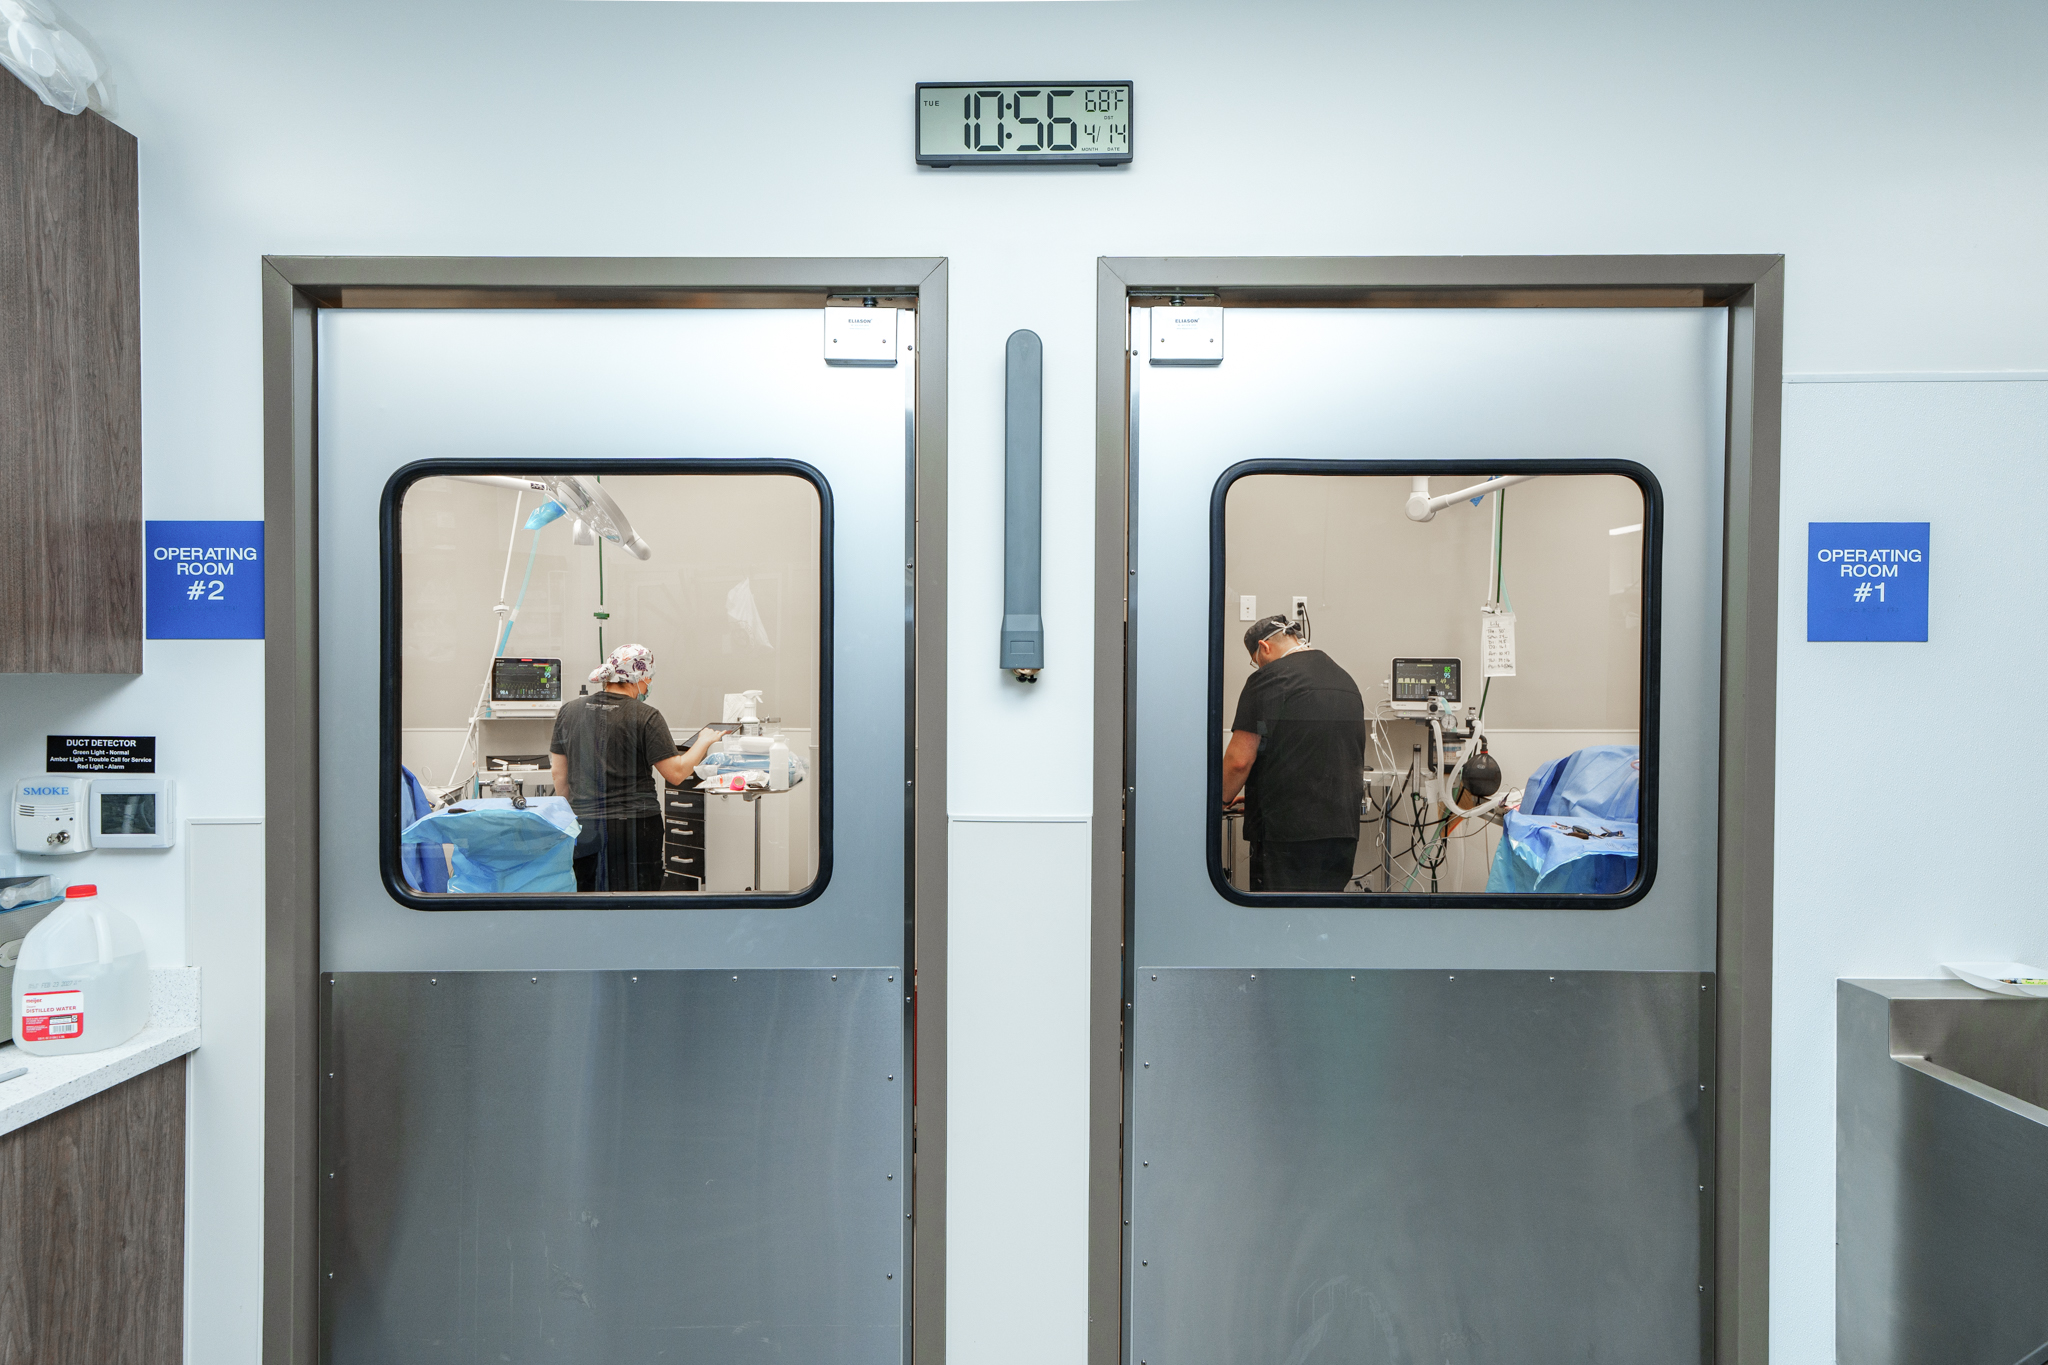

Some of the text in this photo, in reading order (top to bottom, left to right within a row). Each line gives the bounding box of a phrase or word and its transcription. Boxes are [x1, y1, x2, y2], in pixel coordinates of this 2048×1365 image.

[964, 90, 1077, 151] 10:56
[153, 547, 257, 561] OPERATING
[1817, 549, 1922, 562] OPERATING
[176, 562, 234, 576] ROOM
[1840, 564, 1898, 578] ROOM
[186, 580, 225, 601] #2
[1853, 582, 1885, 602] #1
[66, 739, 137, 747] DUCT DETECTOR
[90, 749, 105, 757] Light
[23, 786, 69, 796] SMOKE
